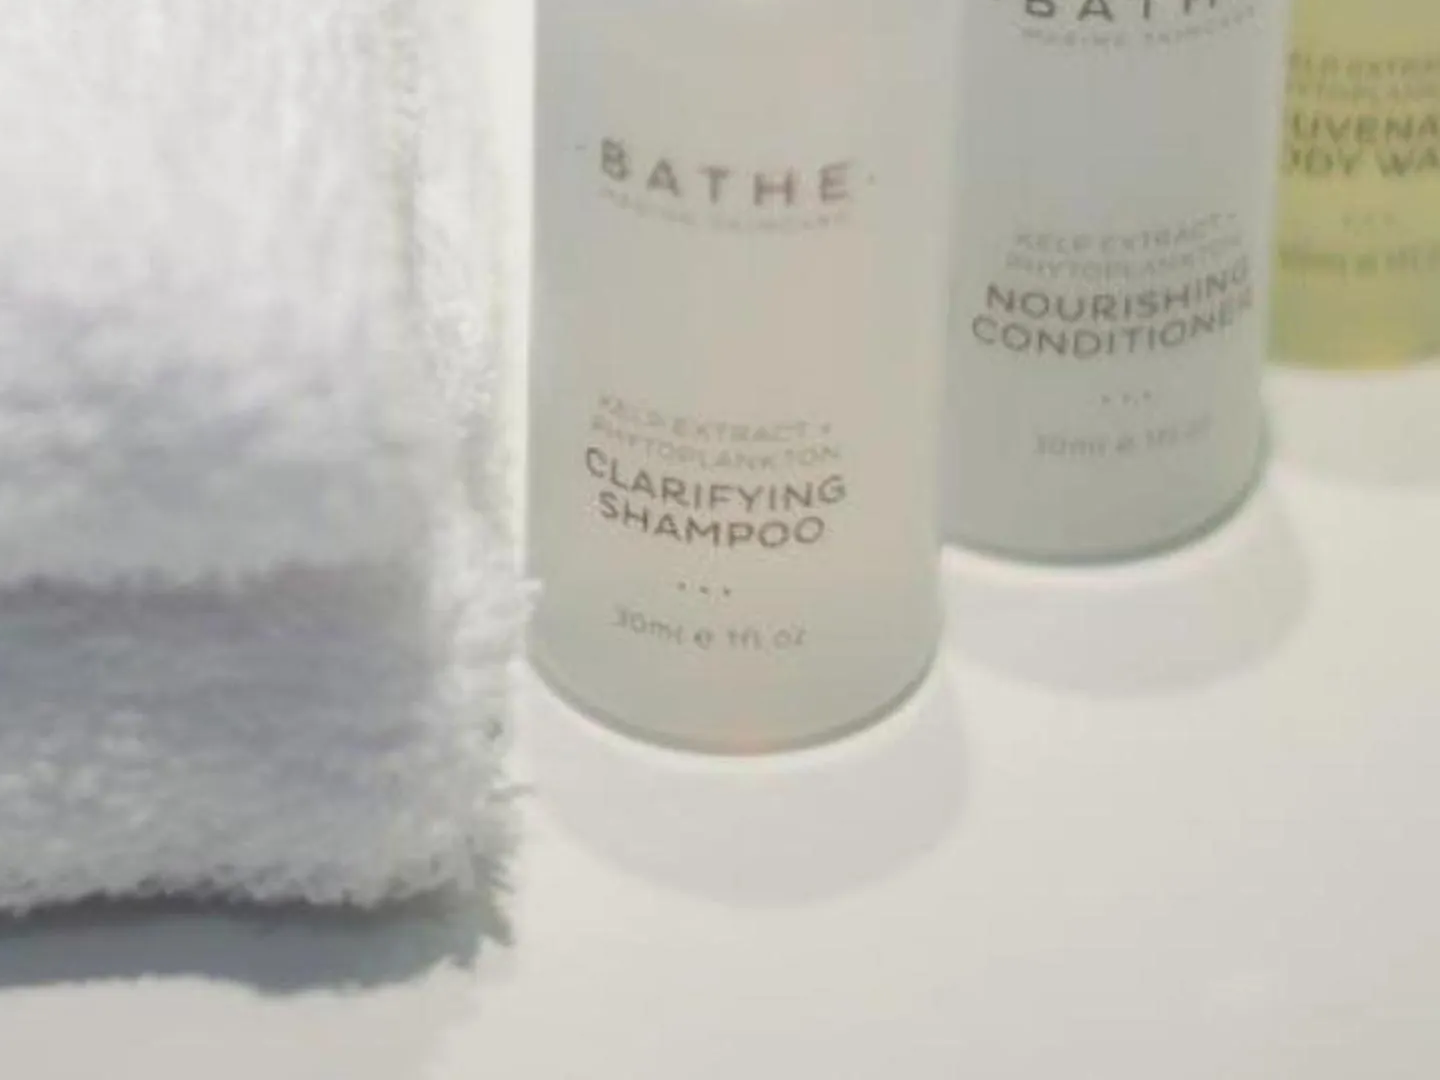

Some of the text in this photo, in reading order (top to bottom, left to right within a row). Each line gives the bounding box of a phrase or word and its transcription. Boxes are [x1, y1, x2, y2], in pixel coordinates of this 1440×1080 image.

[600, 135, 855, 208] BATHE
[985, 255, 1250, 322] NOURISHING
[971, 285, 1254, 361] CONDITIONER
[584, 445, 848, 512] CLARIFYING
[597, 490, 827, 550] SHAMPOO
